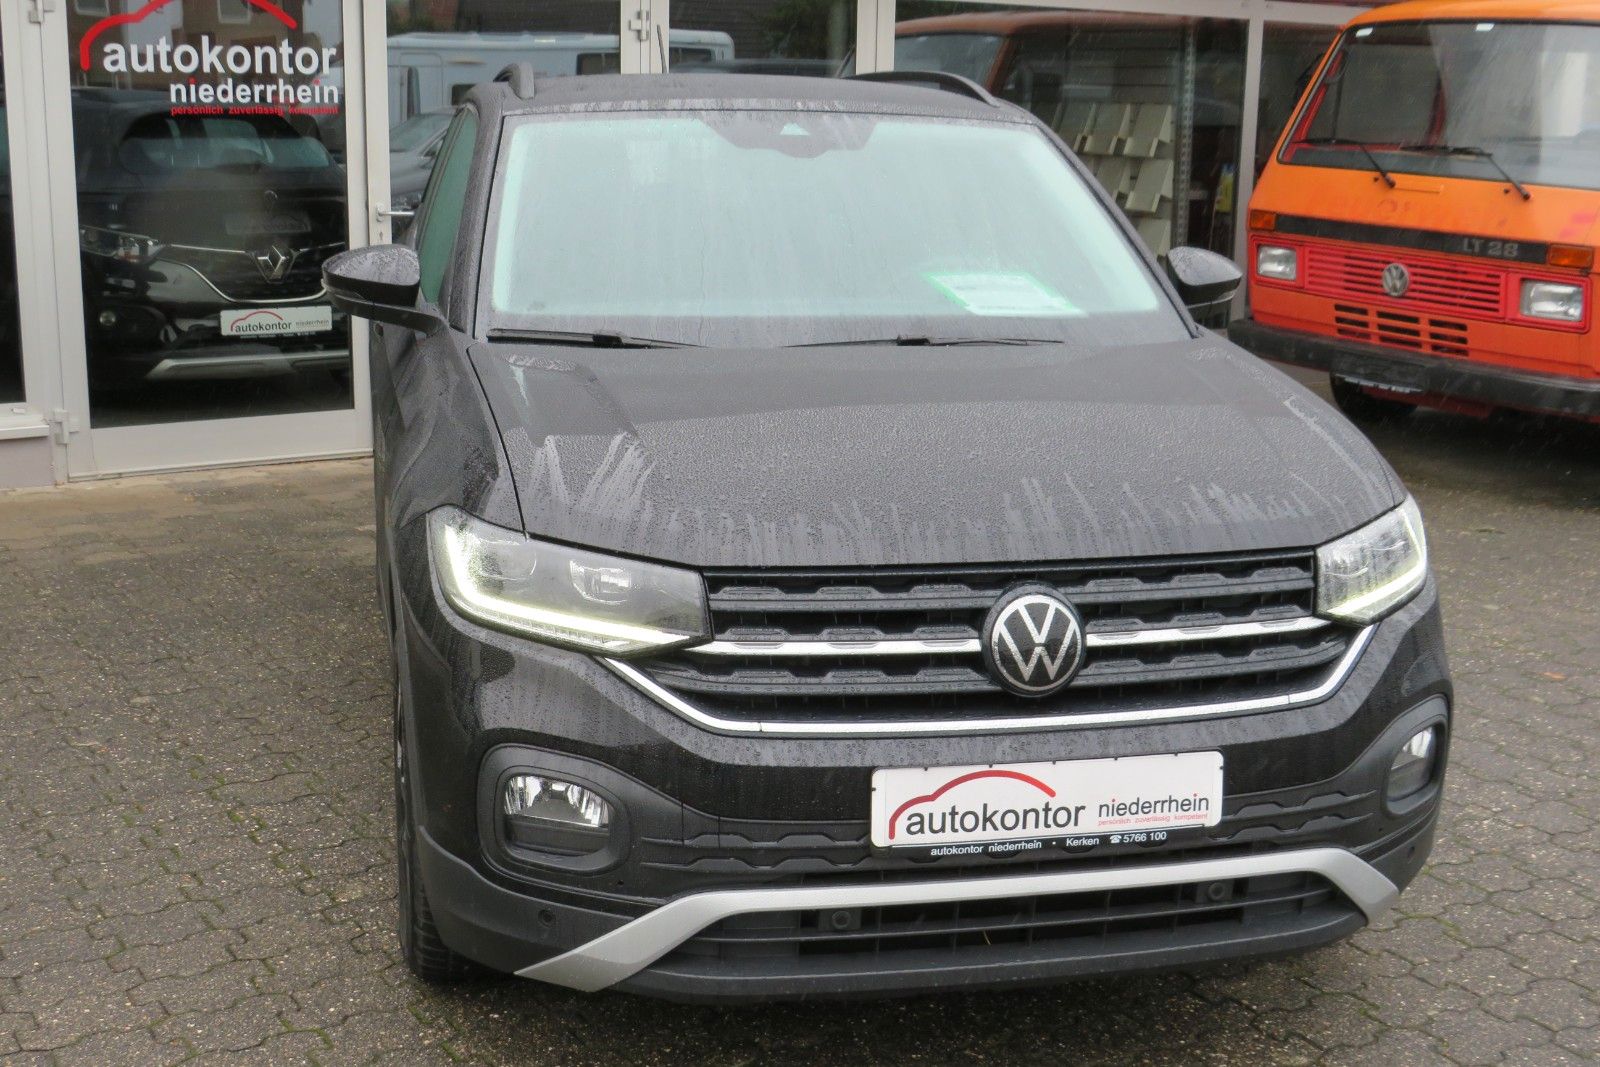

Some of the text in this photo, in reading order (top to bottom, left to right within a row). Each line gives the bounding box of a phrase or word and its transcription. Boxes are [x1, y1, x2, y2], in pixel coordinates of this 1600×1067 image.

[103, 35, 337, 75] autokontor
[169, 78, 339, 104] niederrhein
[170, 105, 224, 116] persönlich
[1463, 238, 1519, 257] LT 28
[235, 321, 292, 333] autokontor
[992, 594, 1082, 691] VW
[905, 793, 1210, 836] autokontor niederrhein
[930, 831, 1167, 856] autokontor niederrhein Kerken 5766 100
